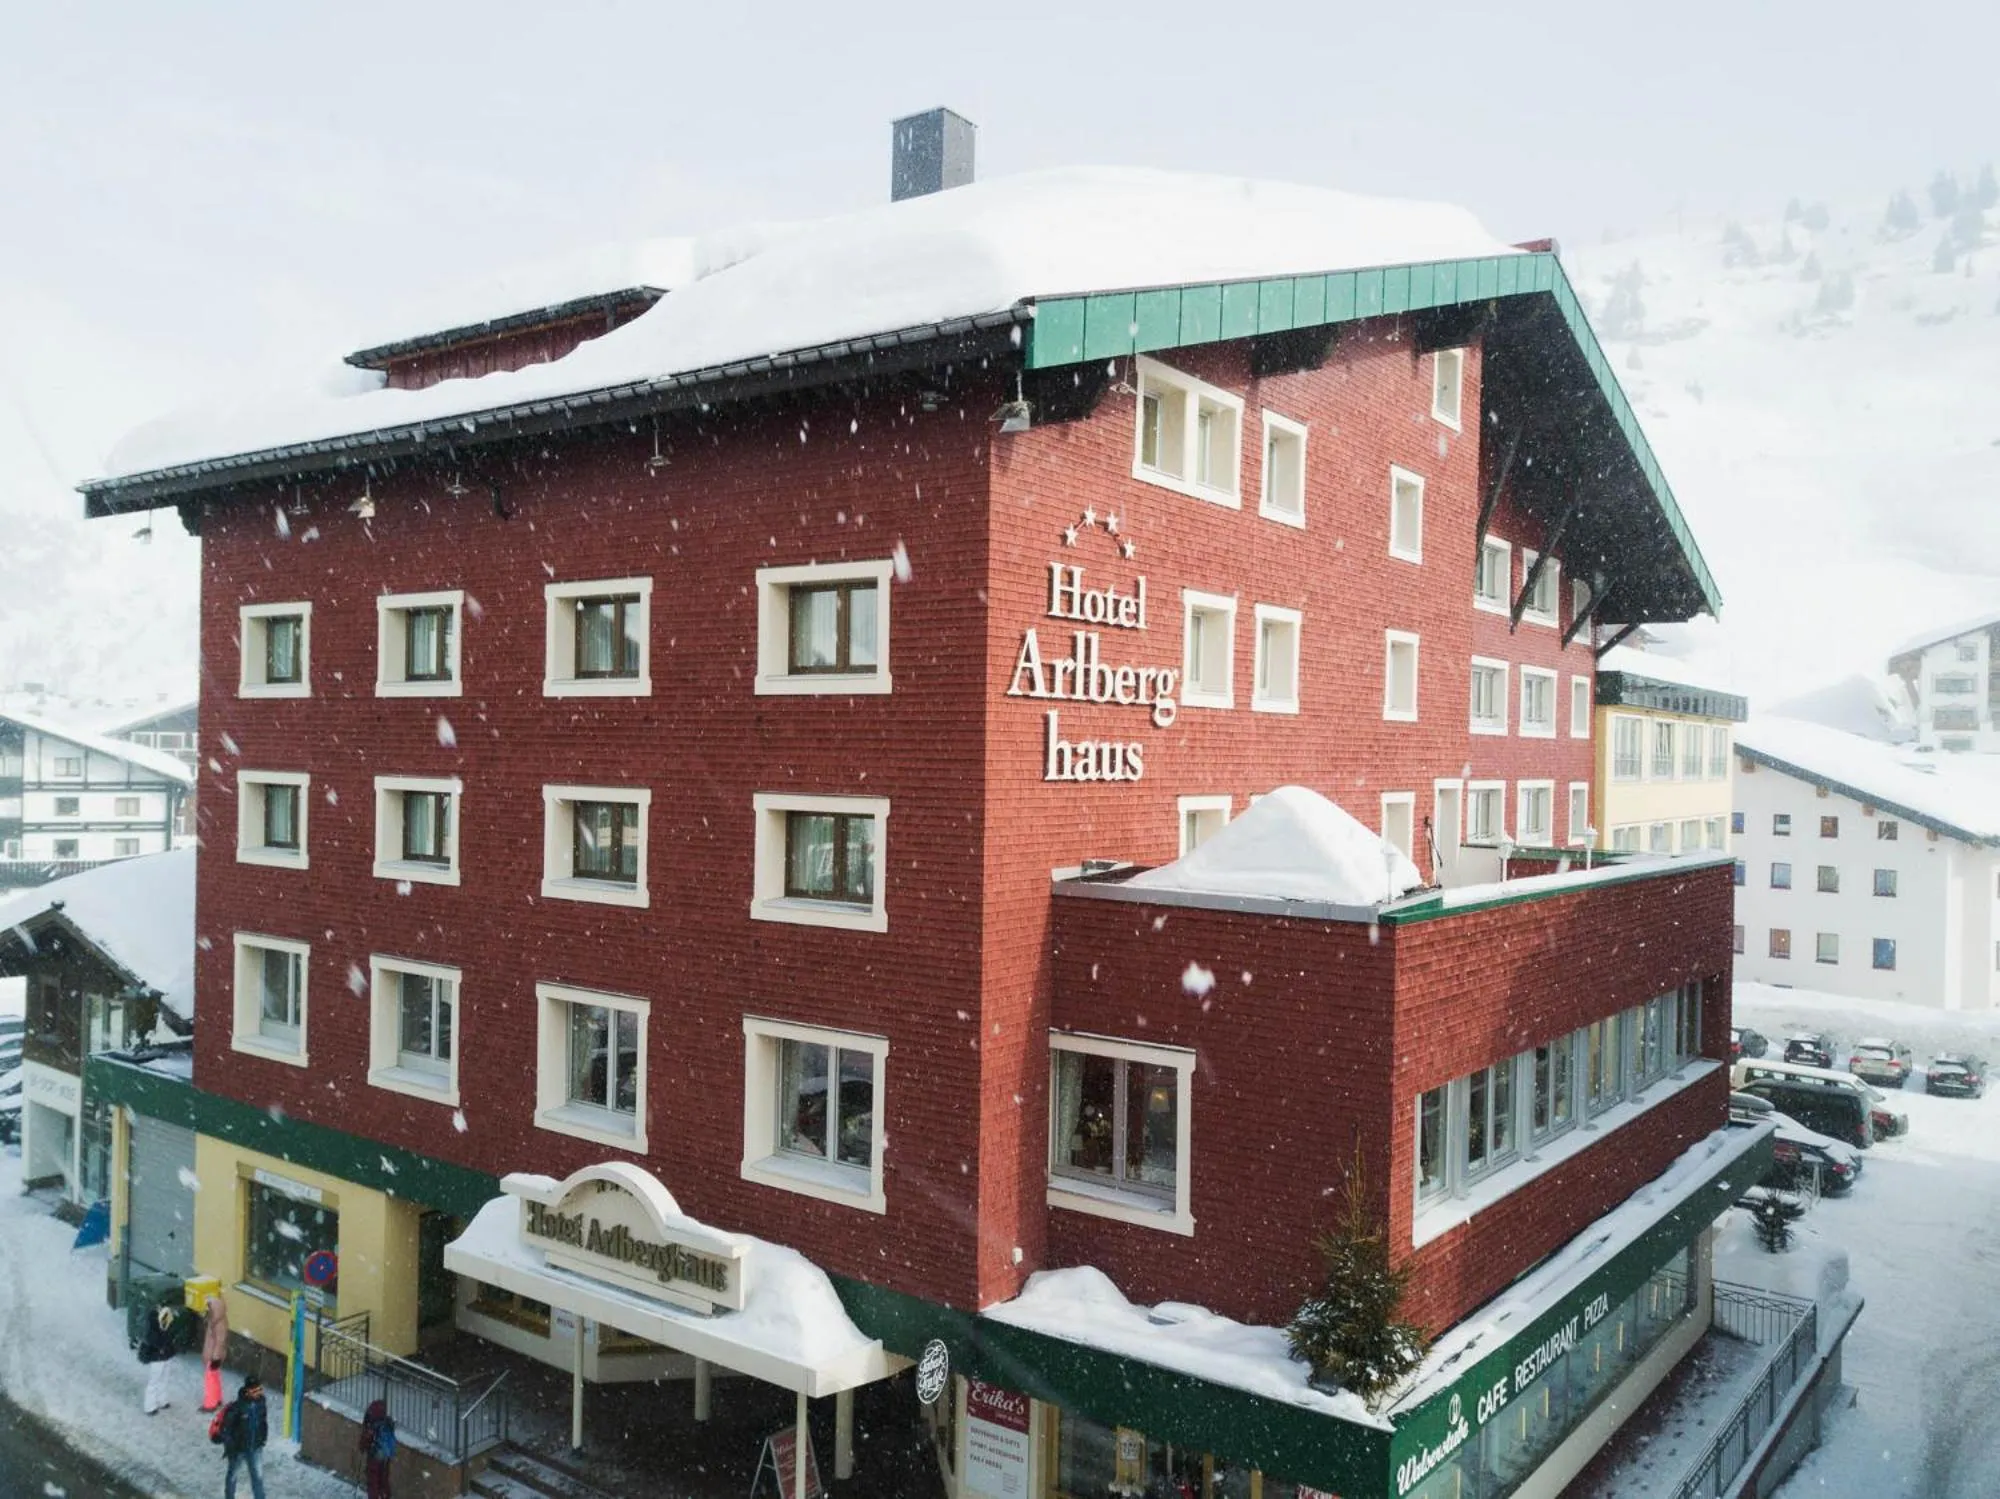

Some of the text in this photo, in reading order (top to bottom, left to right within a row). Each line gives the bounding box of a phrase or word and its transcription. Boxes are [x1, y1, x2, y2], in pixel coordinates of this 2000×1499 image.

[1047, 561, 1147, 629] Hotel
[1006, 627, 1179, 727] Arlberg
[1044, 709, 1144, 782] haus
[527, 1199, 728, 1293] Hotel Arlberghaus
[971, 1381, 1024, 1415] Erika's
[1477, 1376, 1508, 1424] CAFE
[1515, 1315, 1578, 1392] RESTAURANT
[1584, 1292, 1609, 1330] PIZZA
